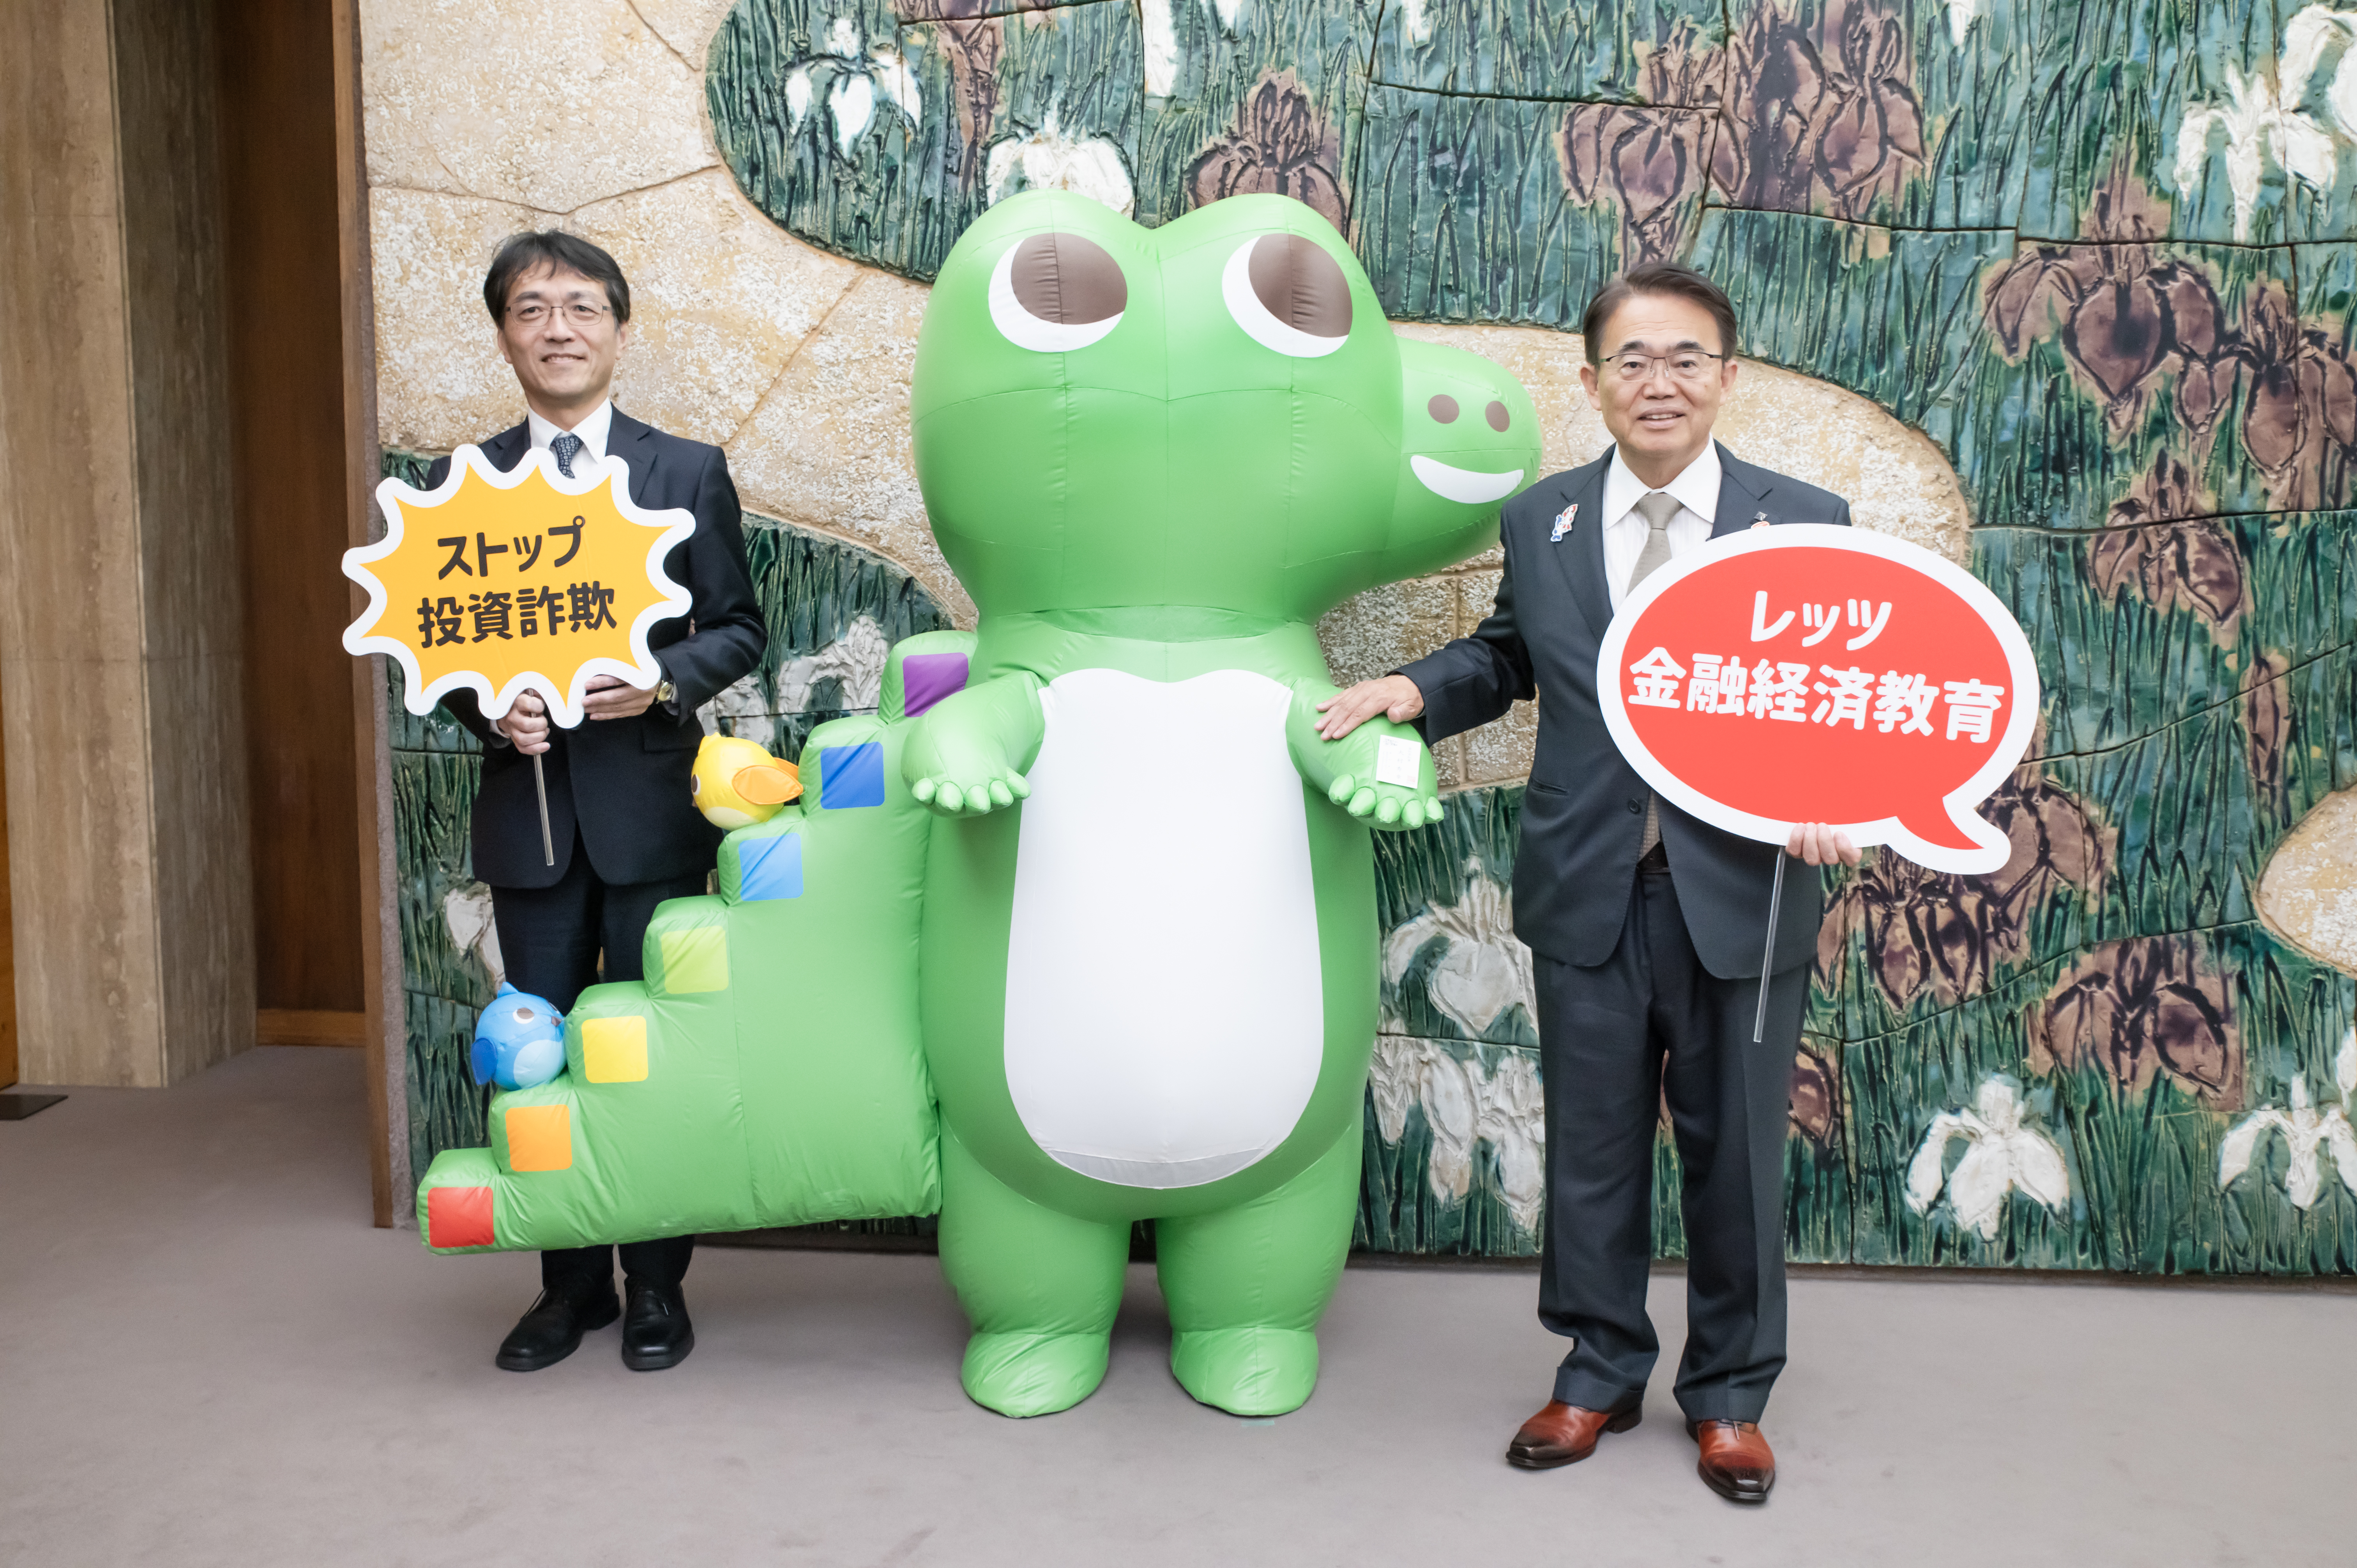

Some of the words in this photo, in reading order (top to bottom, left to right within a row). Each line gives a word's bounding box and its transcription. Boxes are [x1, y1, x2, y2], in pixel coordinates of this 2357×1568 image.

[437, 515, 586, 580] ストップ
[417, 581, 617, 648] 投資詐欺
[1750, 590, 1892, 651] レッツ
[1627, 646, 2005, 743] 金融経済教育
